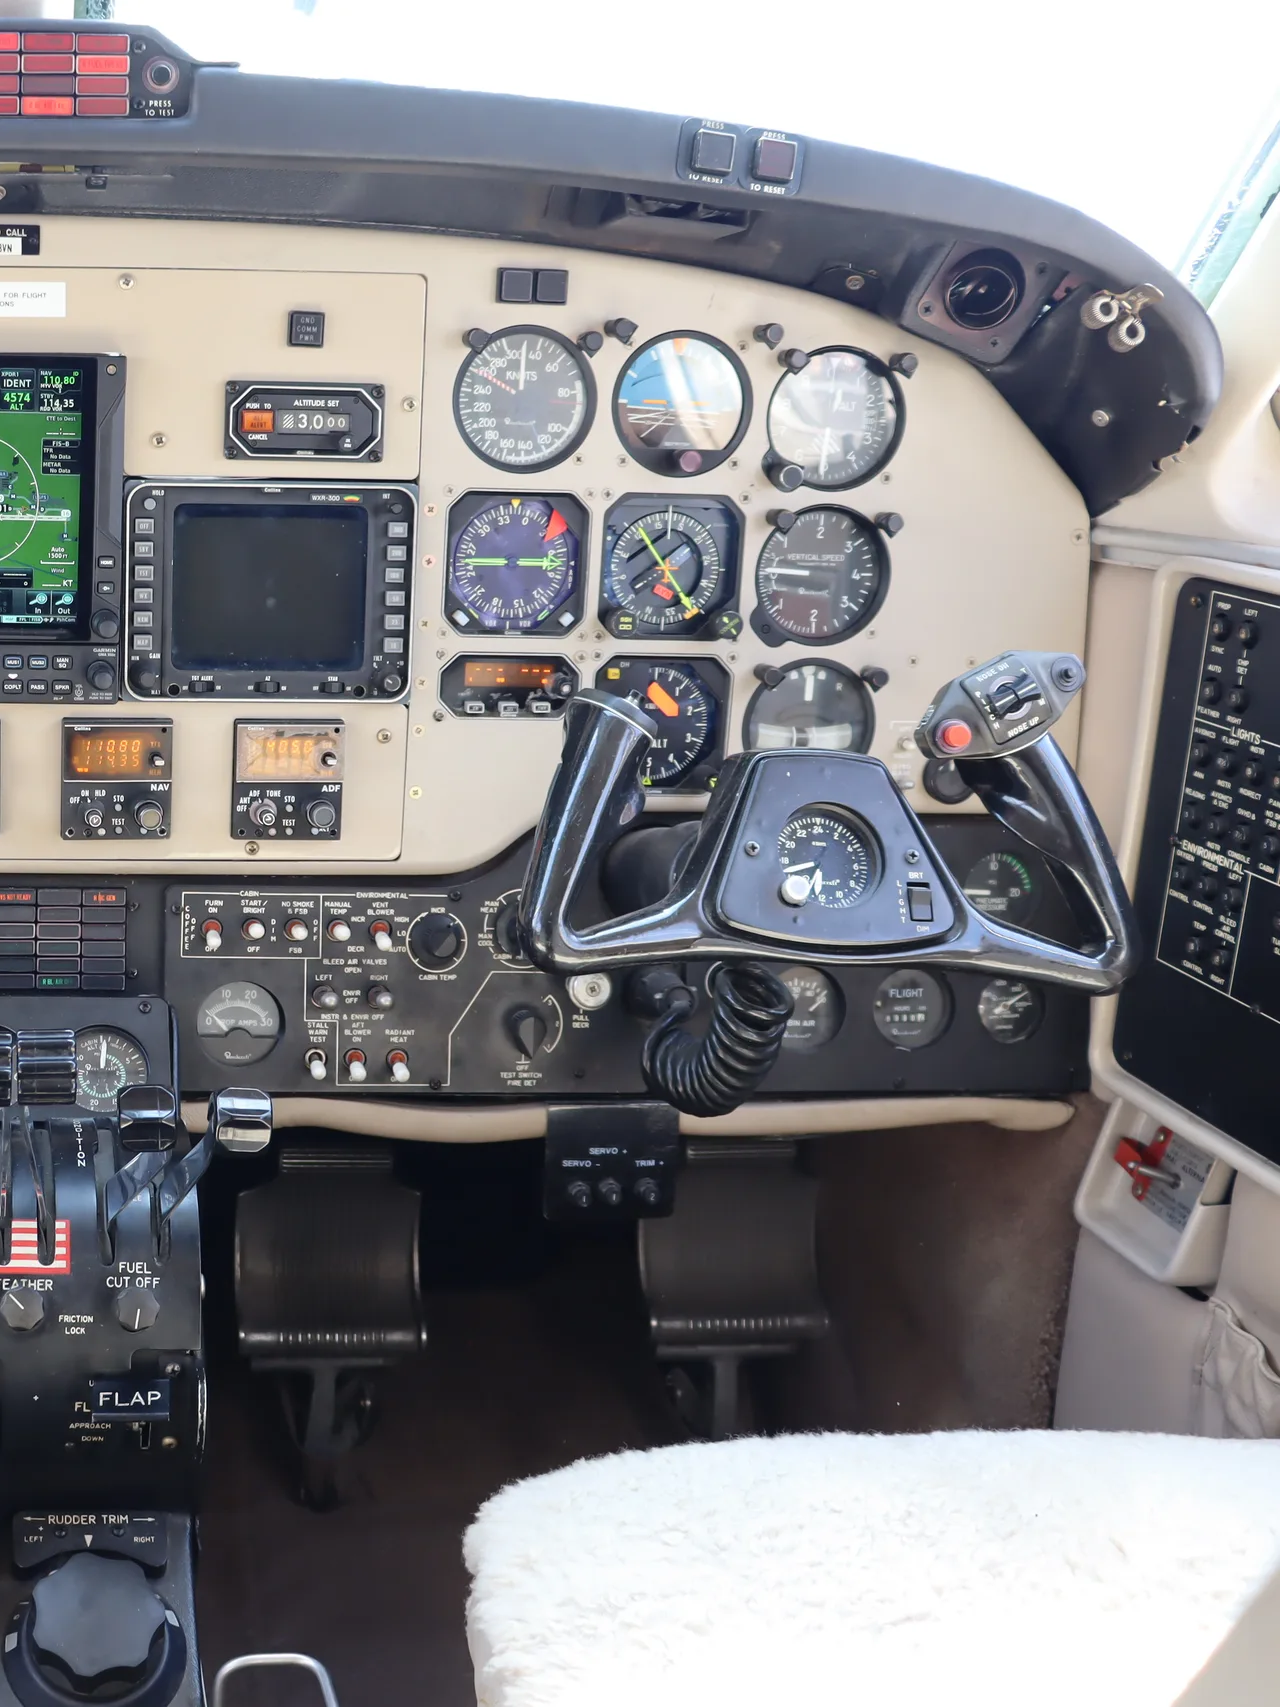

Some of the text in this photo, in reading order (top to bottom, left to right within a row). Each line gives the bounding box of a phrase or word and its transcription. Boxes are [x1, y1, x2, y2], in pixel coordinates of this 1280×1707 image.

[750, 183, 785, 194] TO RESET
[6, 229, 27, 237] CALL
[4, 379, 31, 388] IDENT
[43, 376, 75, 384] 110.80
[4, 393, 31, 402] 4574
[43, 399, 74, 408] 114.35
[1008, 717, 1039, 738] NOSE UP
[1232, 727, 1261, 745] LIGHTS
[1182, 840, 1244, 875] ENVIRONMENTAL
[890, 988, 923, 999] FLIGHT
[119, 1262, 151, 1274] FUEL
[107, 1277, 160, 1288] CUT OFF
[99, 1392, 161, 1407] FLAP
[48, 1514, 129, 1525] RUDDER TRIM
